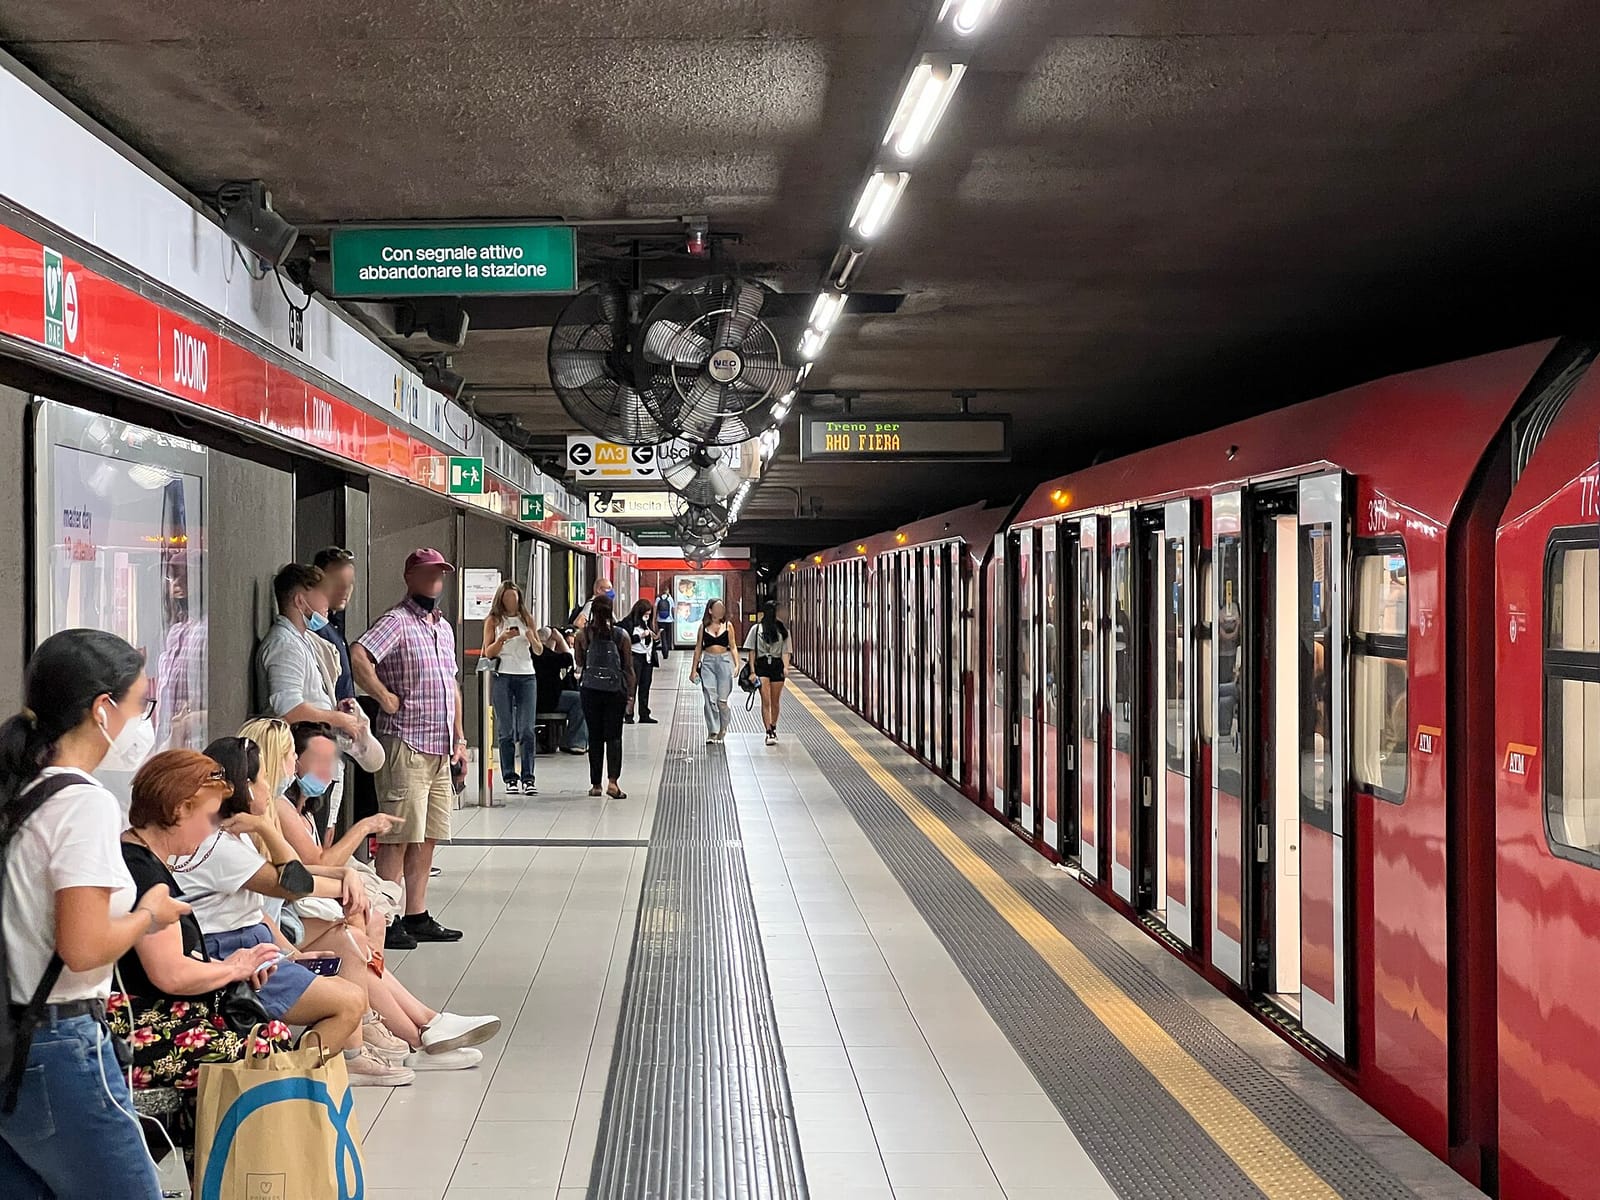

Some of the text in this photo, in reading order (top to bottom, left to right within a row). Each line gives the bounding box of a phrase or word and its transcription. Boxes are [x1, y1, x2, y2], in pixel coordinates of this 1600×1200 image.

[382, 244, 524, 262] Con segnale attivo
[359, 262, 547, 280] abbandonare la stazione
[48, 322, 61, 346] DAE
[173, 328, 208, 394] DUOMO
[825, 422, 900, 432] Treno per
[825, 433, 900, 451] RHO FIERA
[598, 447, 625, 461] M3
[629, 501, 662, 511] Uscita
[82, 504, 92, 535] day
[1419, 733, 1432, 754] ATM
[1509, 752, 1525, 775] ATM
